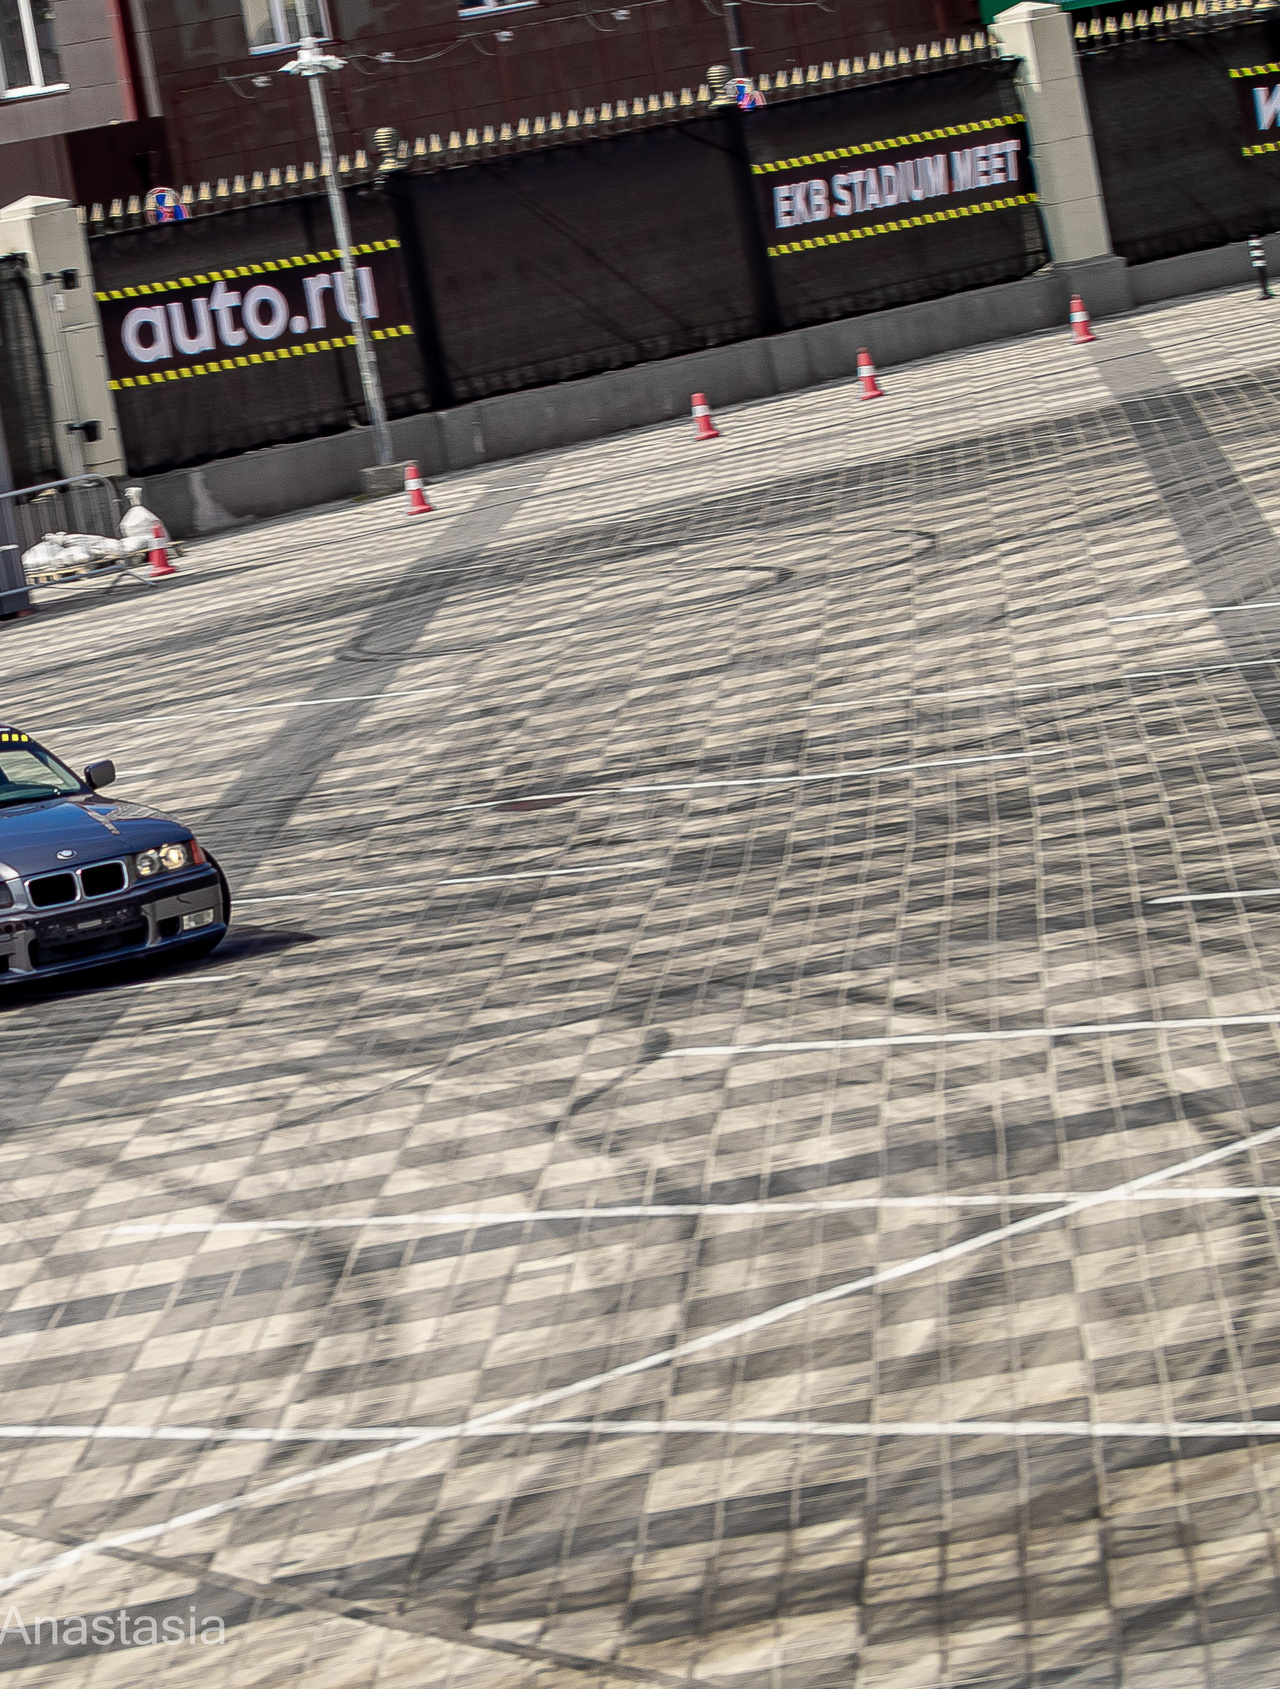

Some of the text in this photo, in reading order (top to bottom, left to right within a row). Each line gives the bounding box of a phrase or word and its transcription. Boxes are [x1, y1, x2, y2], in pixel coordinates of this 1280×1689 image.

[773, 139, 1021, 229] EKB STADIUM MEET
[121, 266, 380, 363] auto.ru
